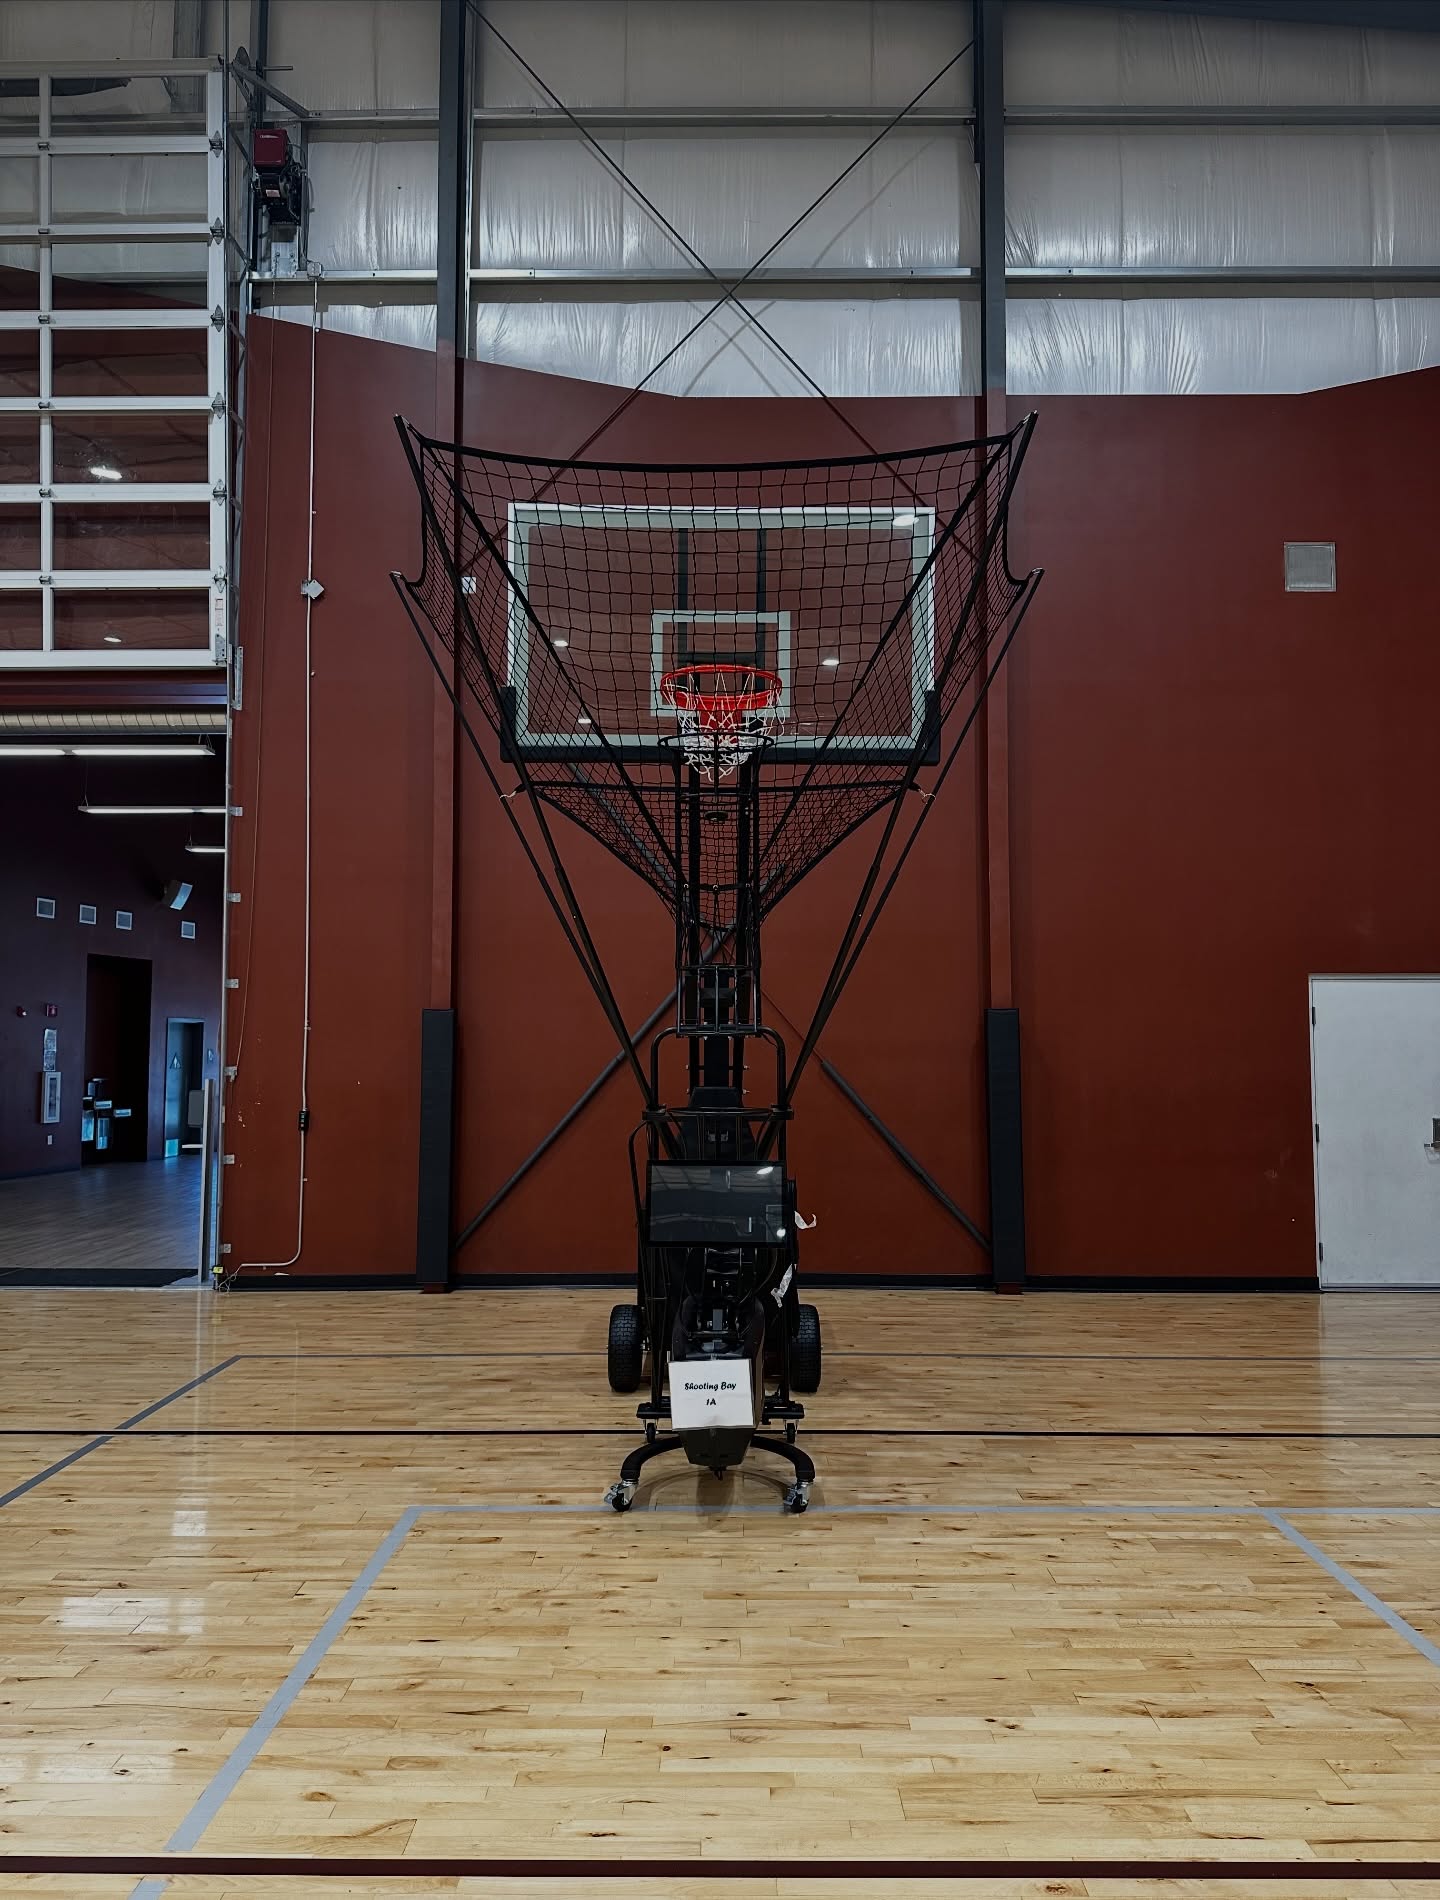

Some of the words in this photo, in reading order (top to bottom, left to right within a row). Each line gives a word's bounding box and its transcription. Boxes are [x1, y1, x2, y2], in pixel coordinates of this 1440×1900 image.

[684, 1382, 719, 1391] Shooting
[720, 1381, 737, 1390] Bay
[706, 1398, 717, 1406] 1A
